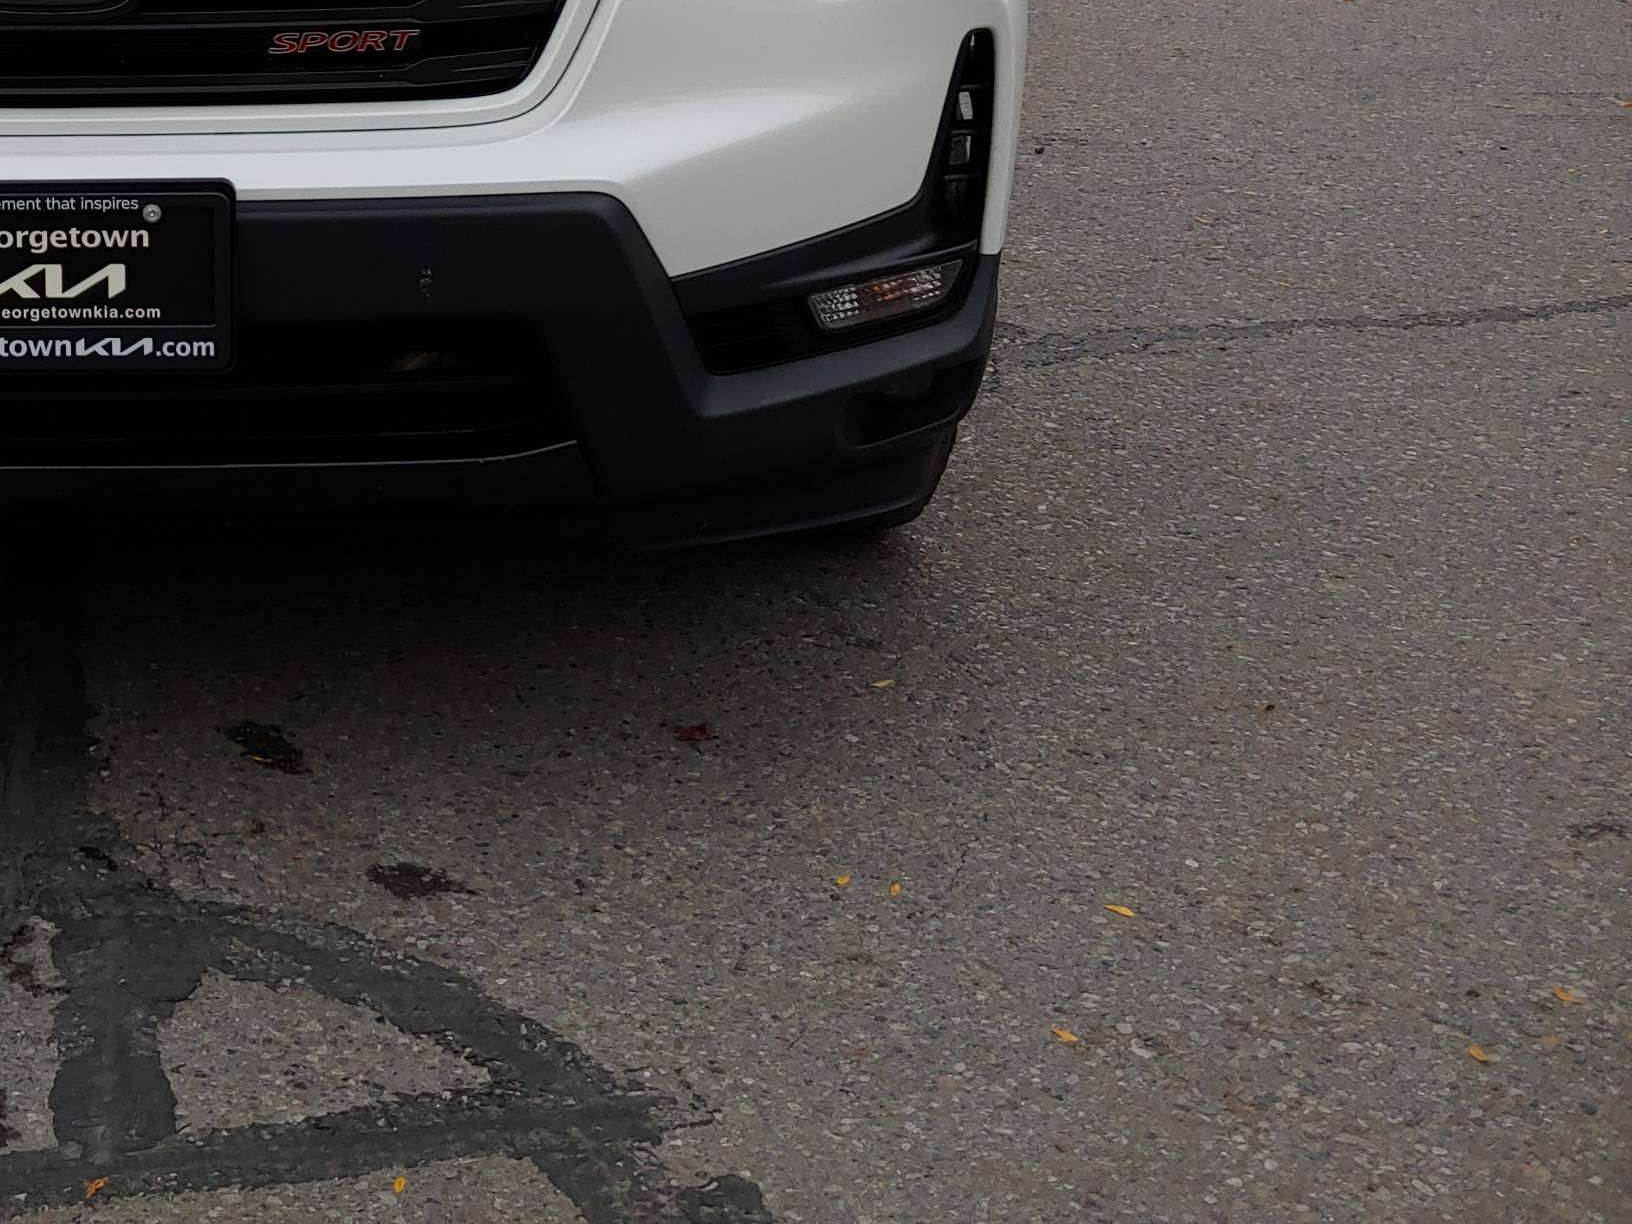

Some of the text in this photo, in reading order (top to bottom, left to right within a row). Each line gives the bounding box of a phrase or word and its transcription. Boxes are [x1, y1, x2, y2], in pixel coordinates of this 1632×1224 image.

[268, 29, 421, 54] SPORT
[45, 196, 76, 211] that
[80, 196, 139, 212] inspires
